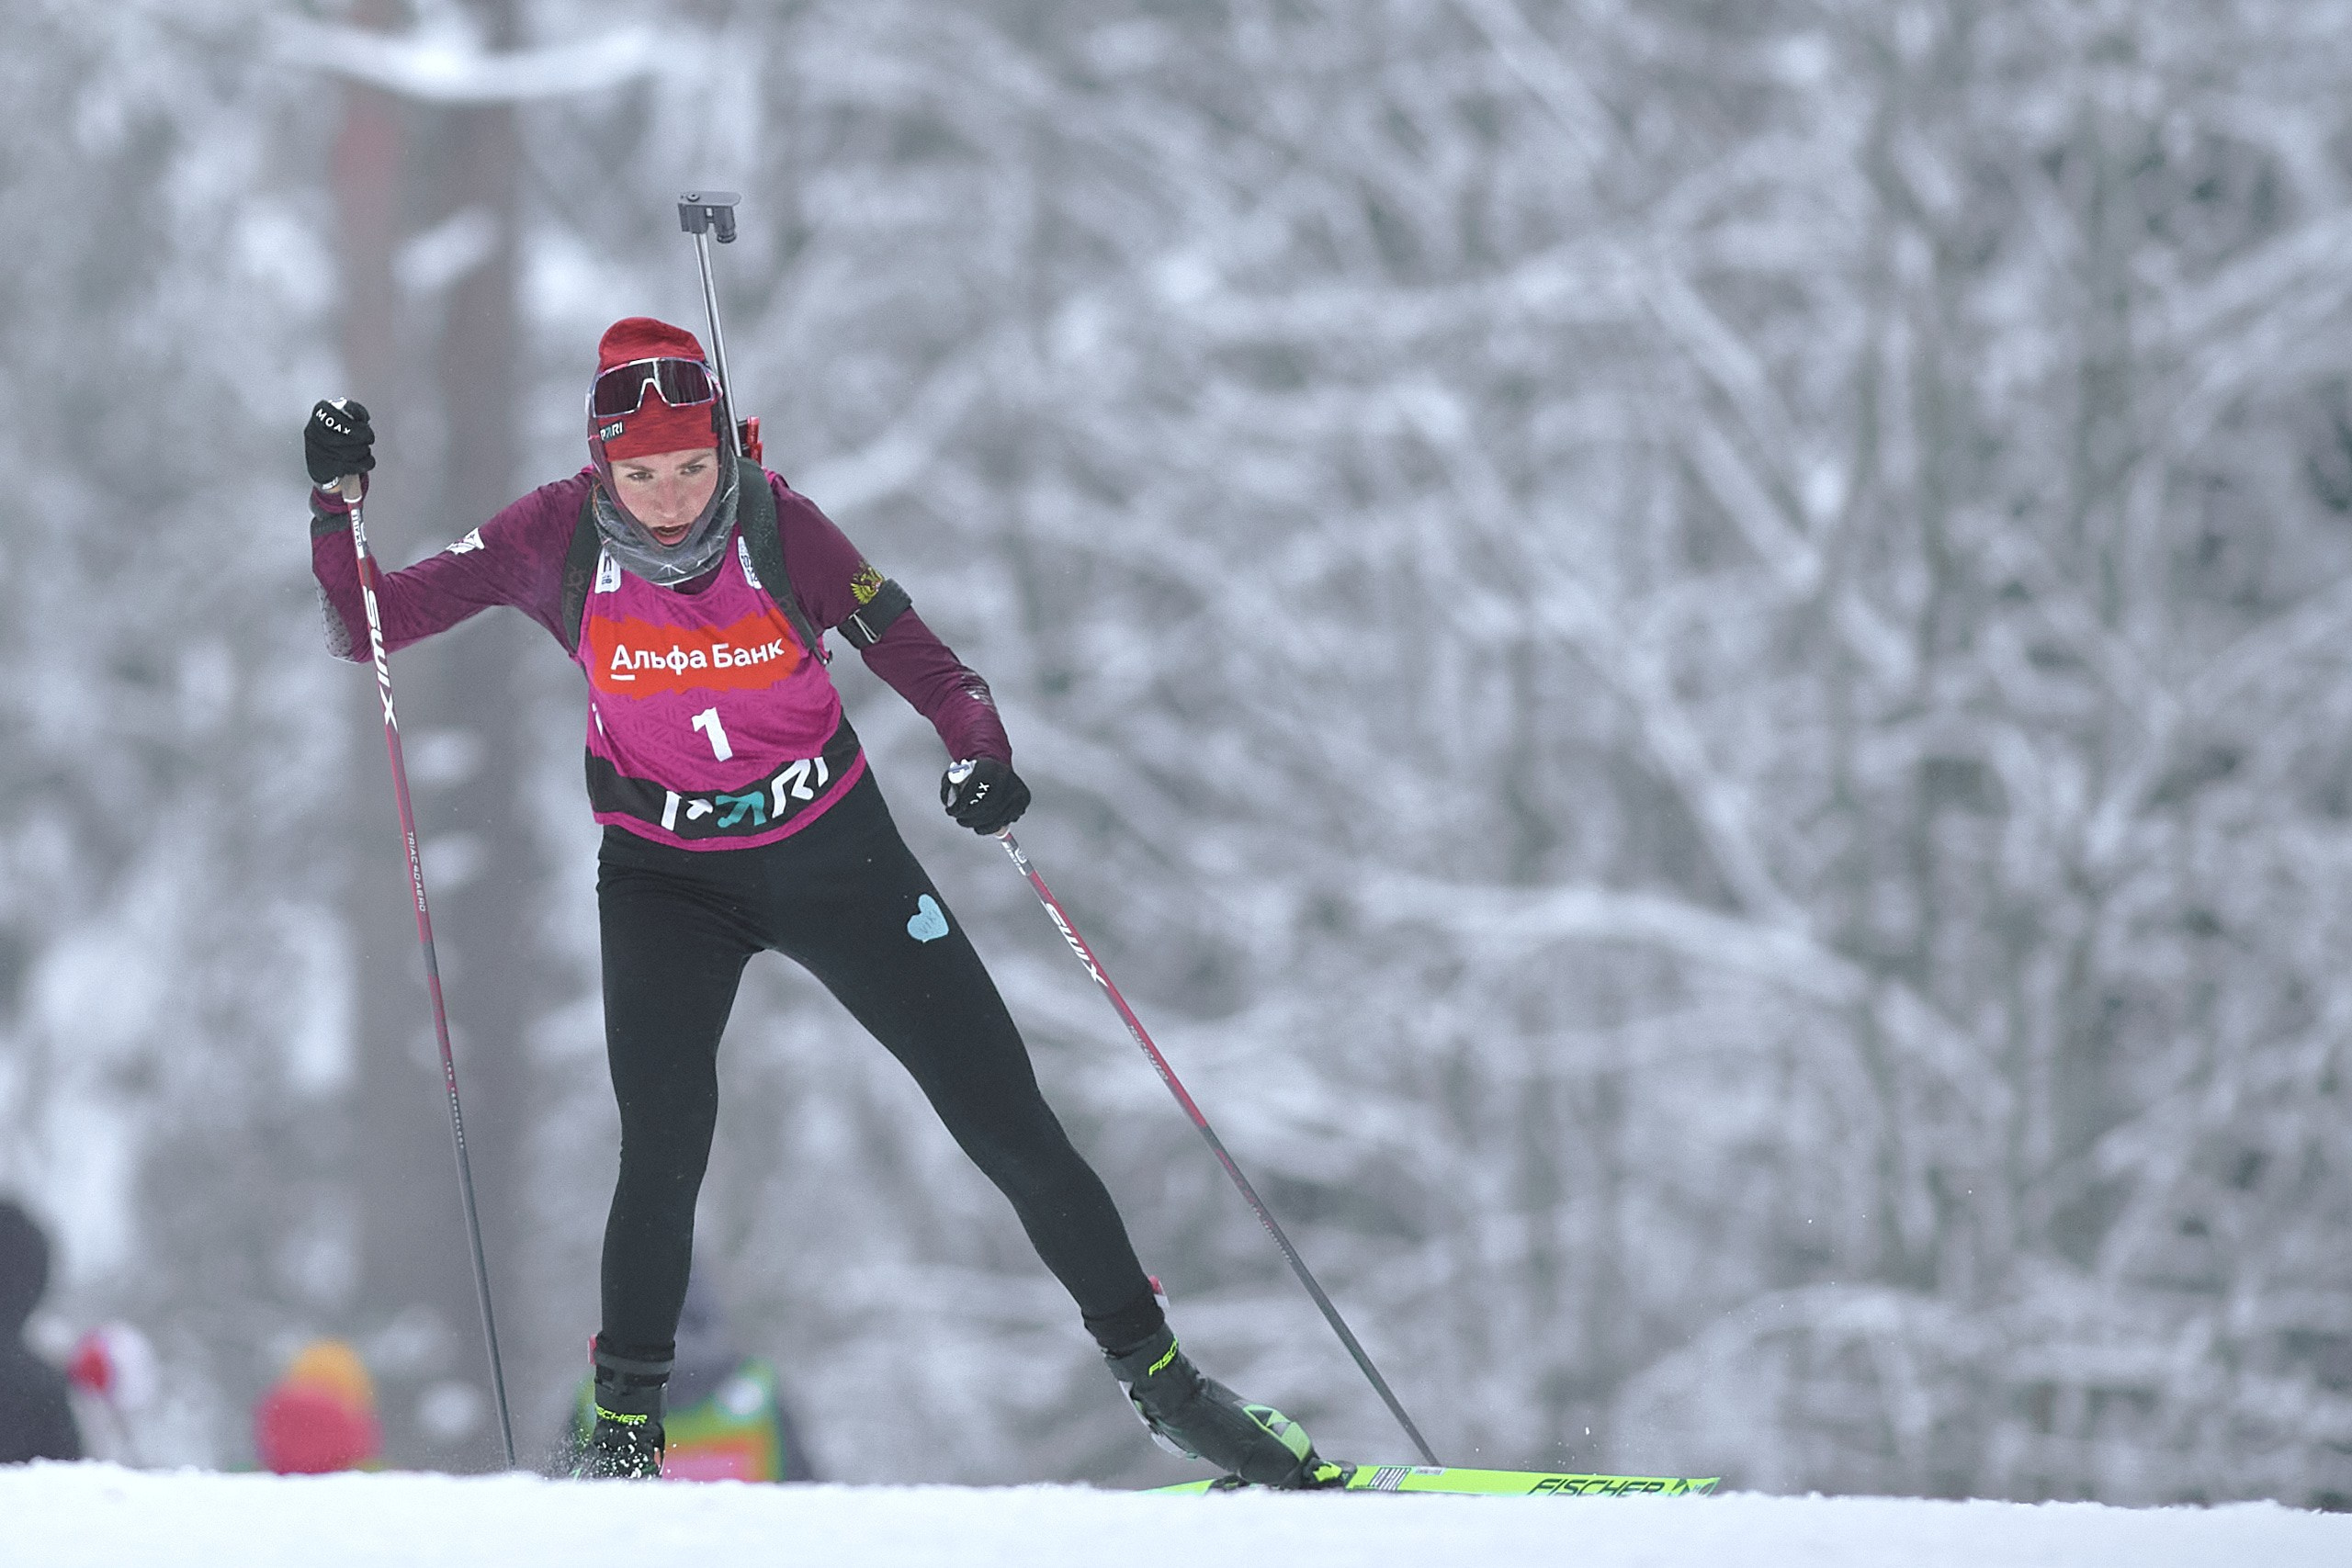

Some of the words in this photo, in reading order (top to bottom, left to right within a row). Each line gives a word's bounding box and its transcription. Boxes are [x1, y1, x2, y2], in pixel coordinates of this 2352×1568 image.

[316, 408, 351, 435] MOAX
[600, 422, 623, 441] PARI
[363, 585, 398, 732] SWIX
[611, 644, 707, 676] Альфа
[712, 638, 785, 669] Банк
[691, 706, 733, 762] 1
[1040, 900, 1108, 987] SWIX
